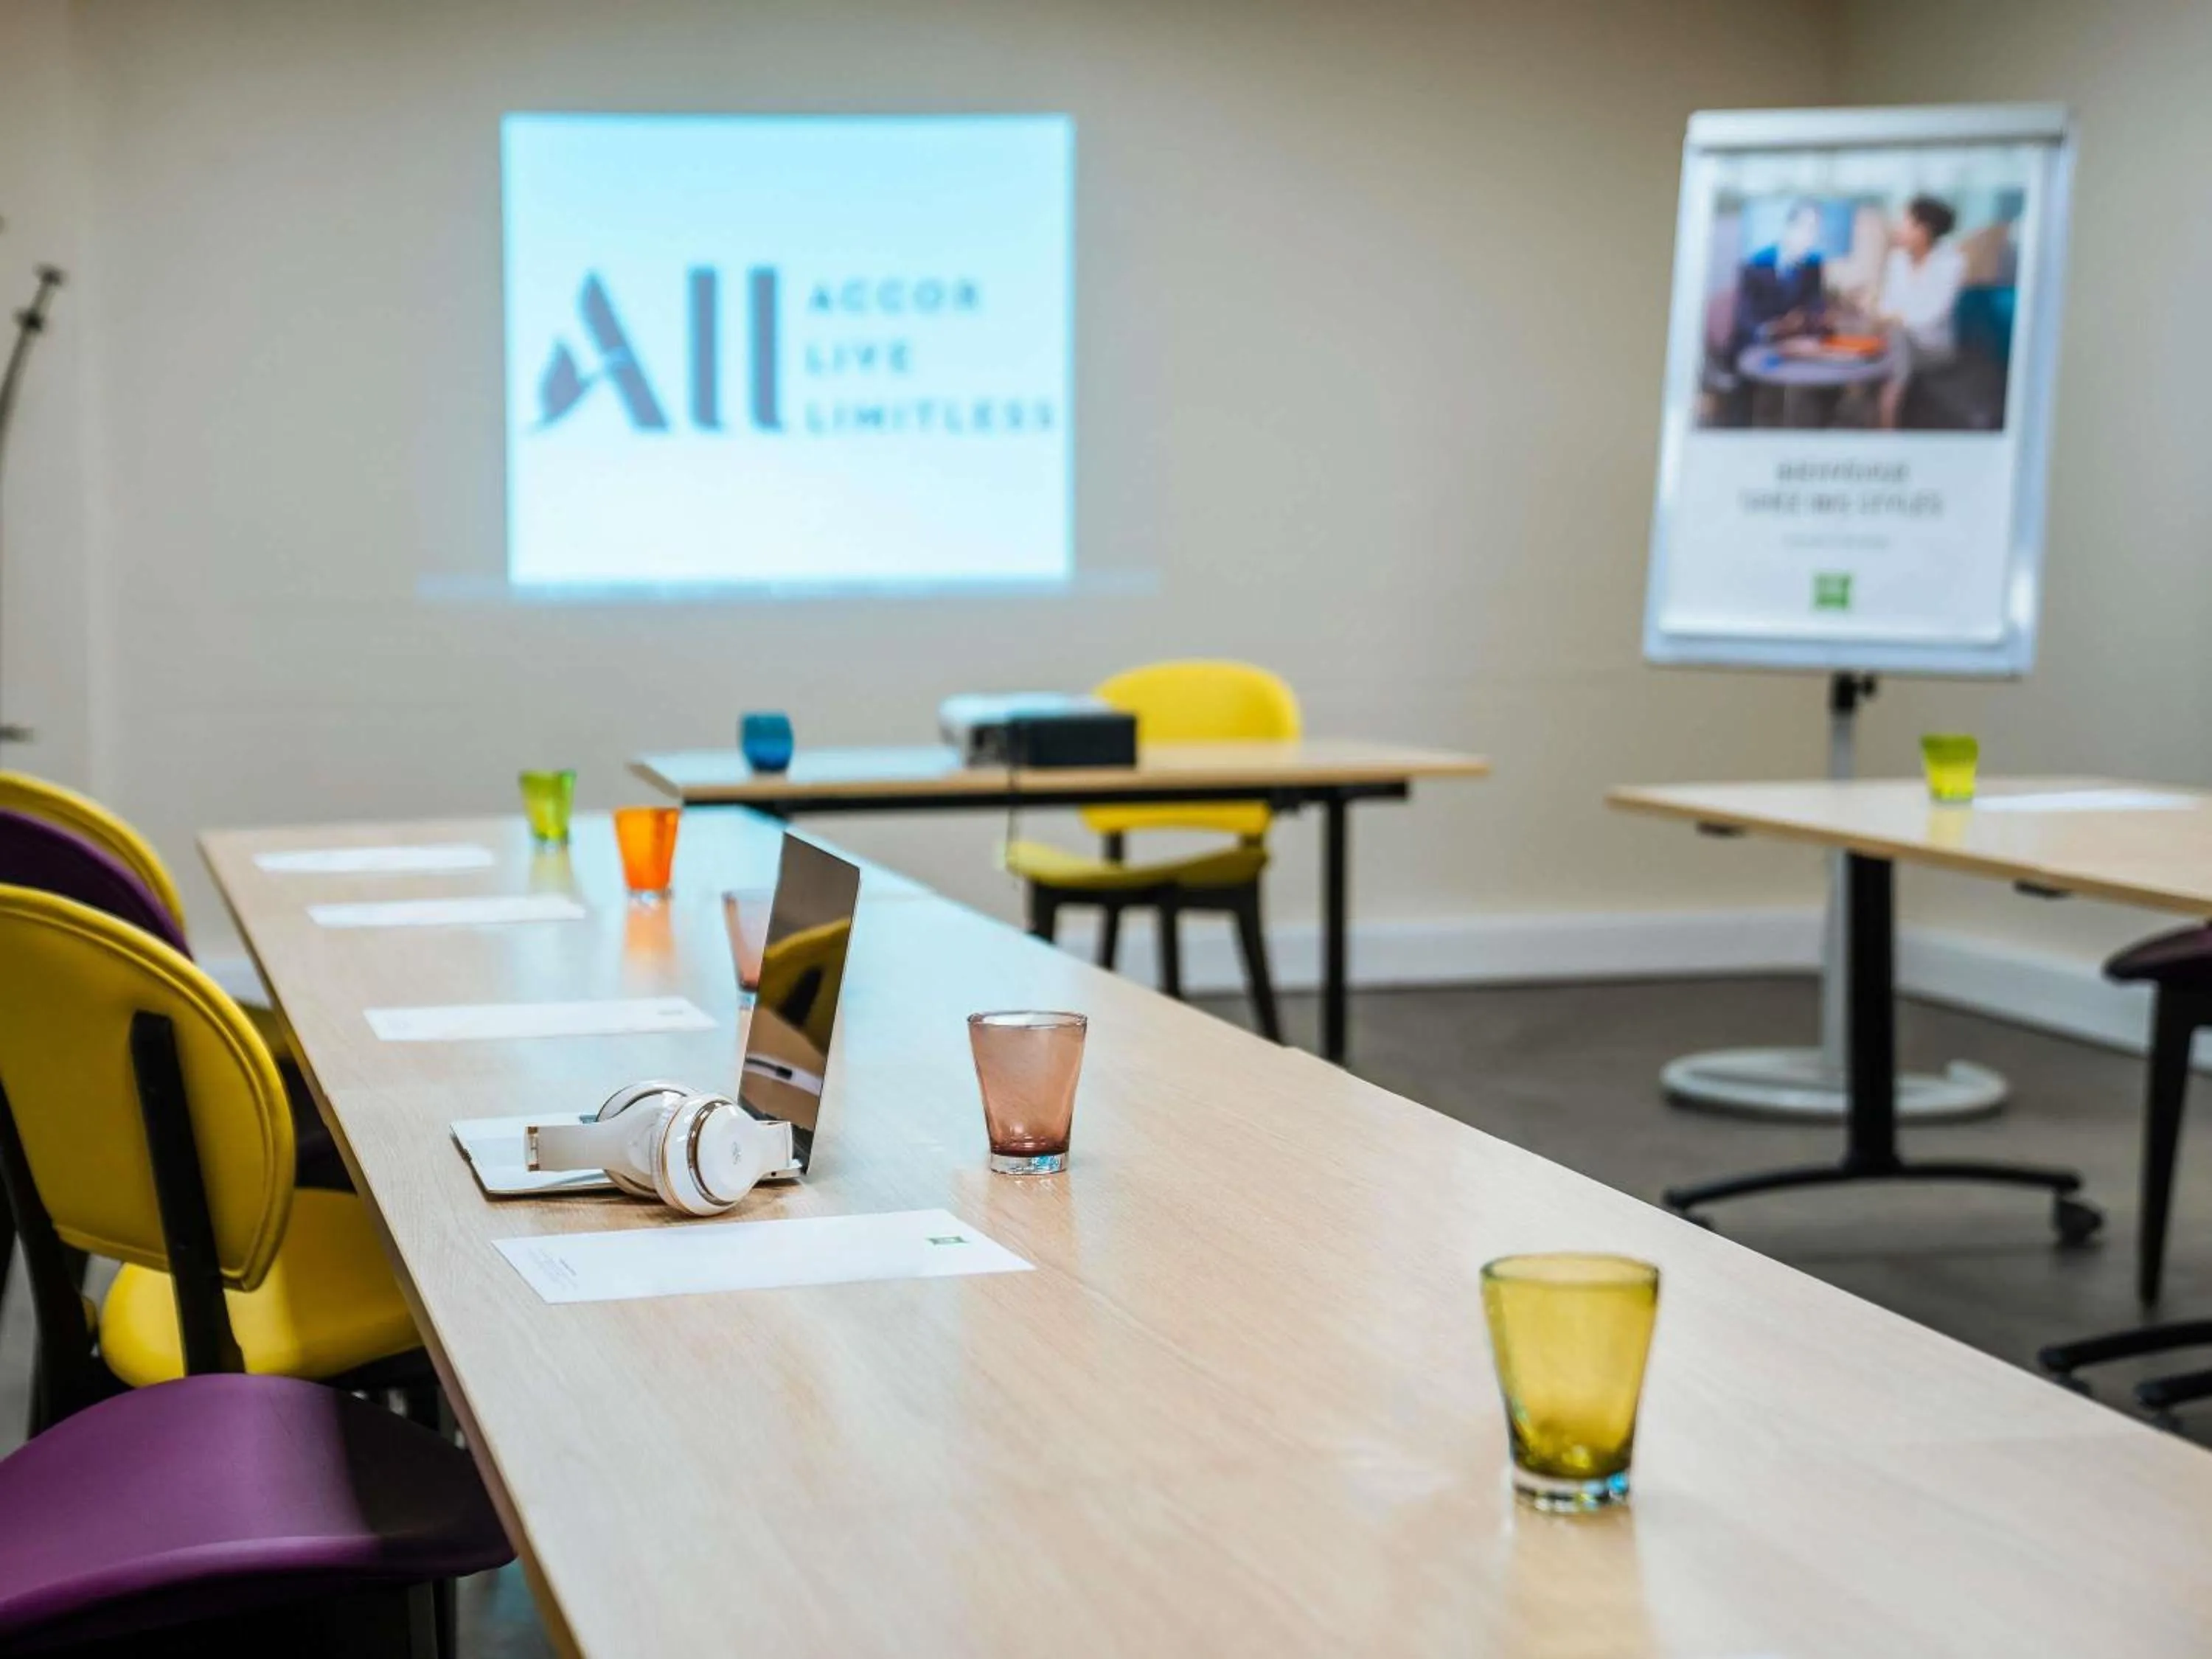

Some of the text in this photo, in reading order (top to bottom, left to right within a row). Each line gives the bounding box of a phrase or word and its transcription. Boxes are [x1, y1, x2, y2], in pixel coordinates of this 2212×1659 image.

[809, 276, 981, 313] ACCOR
[805, 339, 911, 375] LIVE
[805, 400, 1054, 434] LIMITLESS
